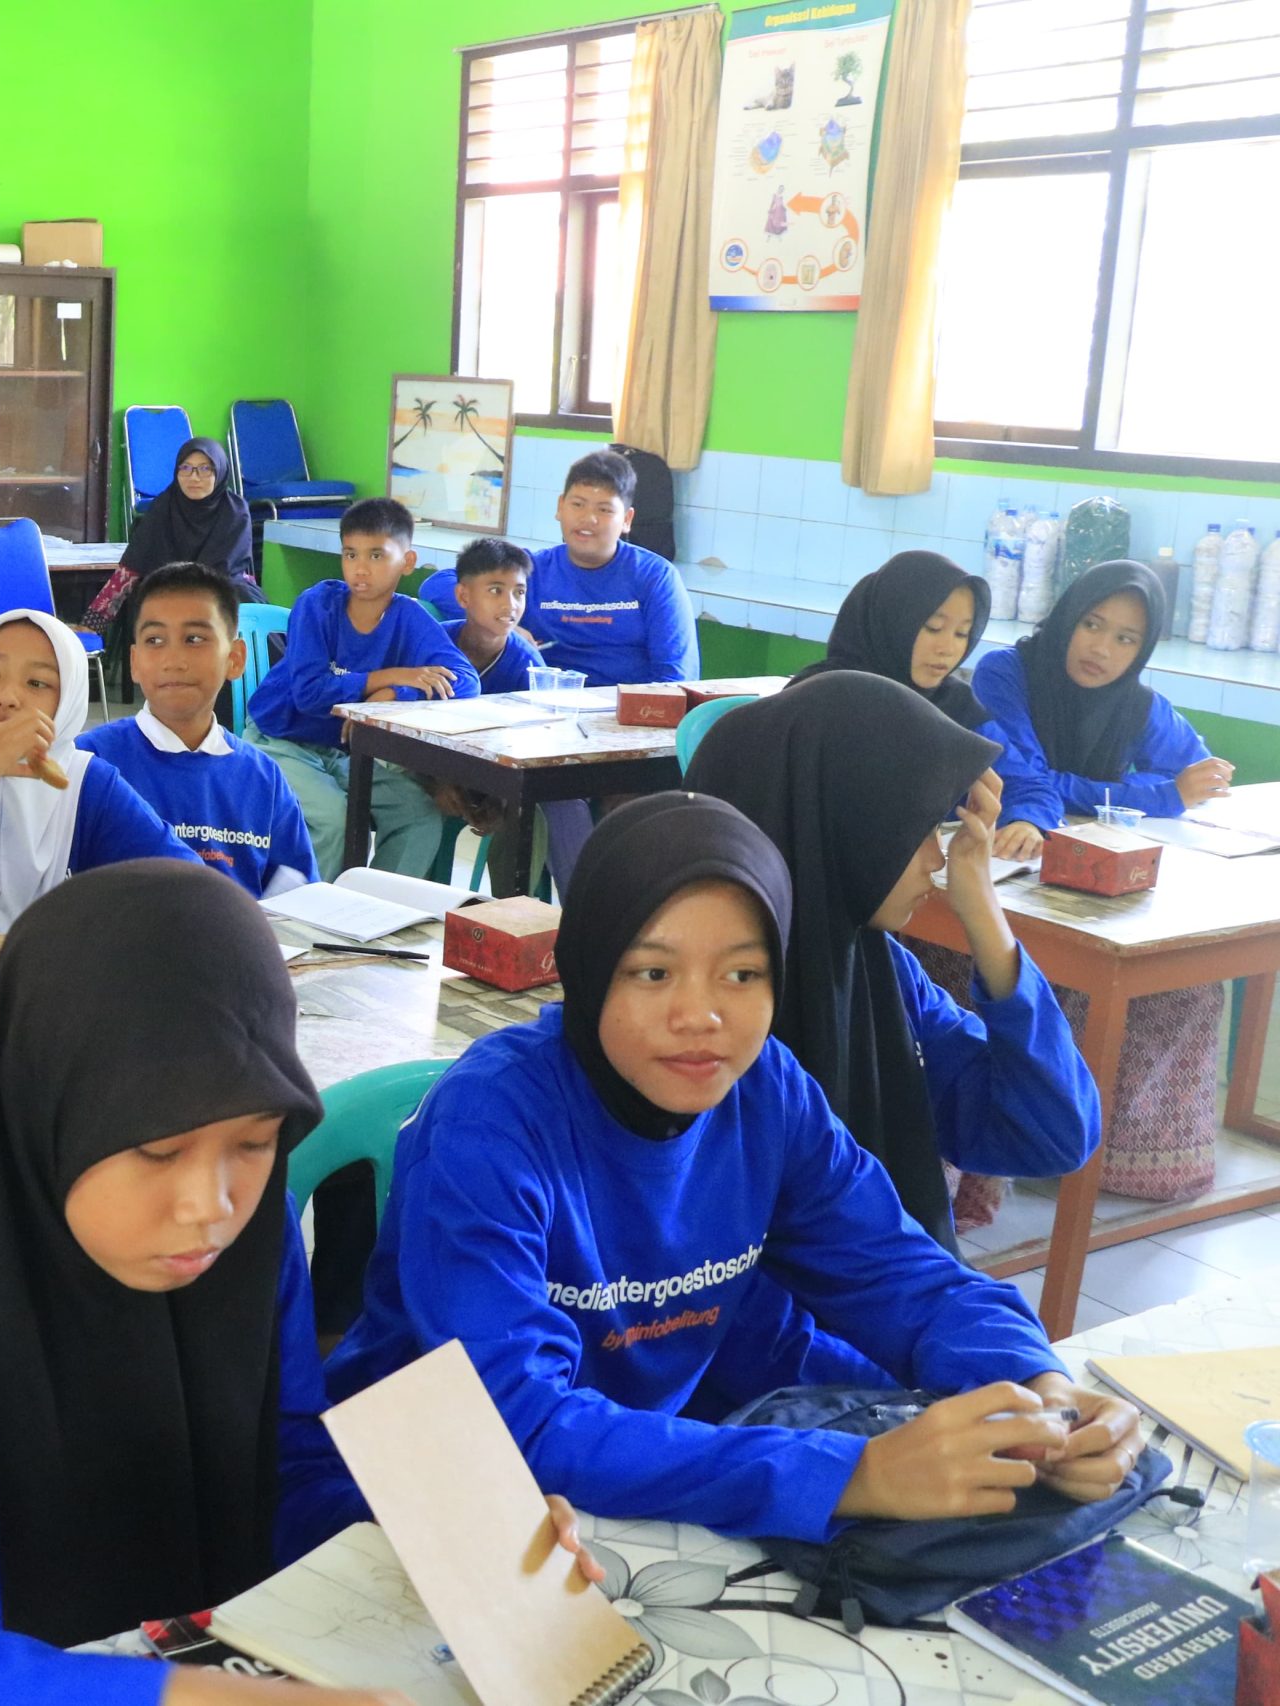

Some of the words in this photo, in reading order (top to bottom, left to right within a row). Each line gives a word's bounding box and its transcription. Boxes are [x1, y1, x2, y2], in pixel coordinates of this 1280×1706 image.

[601, 1329, 624, 1351] by
[1078, 1595, 1229, 1676] UNIVERSITY
[1133, 1626, 1234, 1680] HARVARD
